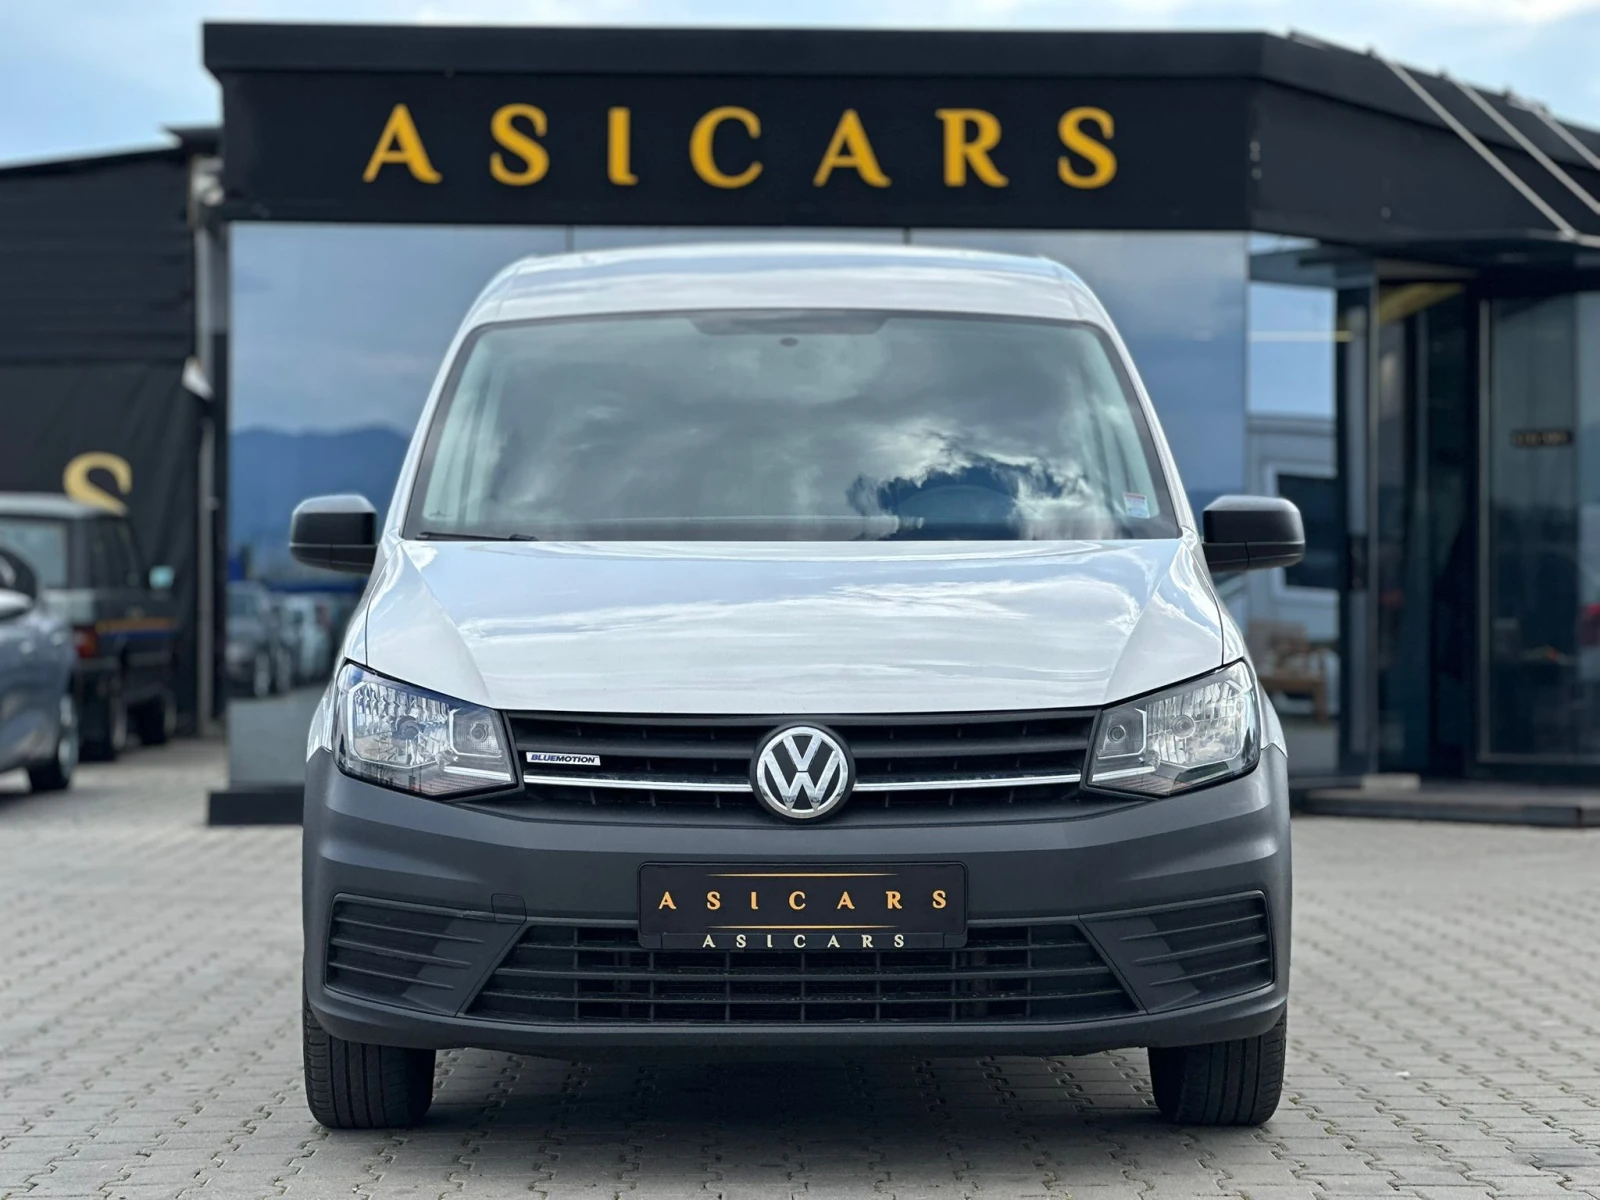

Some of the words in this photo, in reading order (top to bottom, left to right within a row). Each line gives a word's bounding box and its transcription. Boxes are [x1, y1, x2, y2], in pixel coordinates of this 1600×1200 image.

[364, 103, 1118, 189] ASICARS
[531, 754, 596, 764] BLUEMOTION
[757, 726, 849, 819] VW
[658, 889, 947, 911] ASICARS
[702, 933, 905, 949] ASICARS
